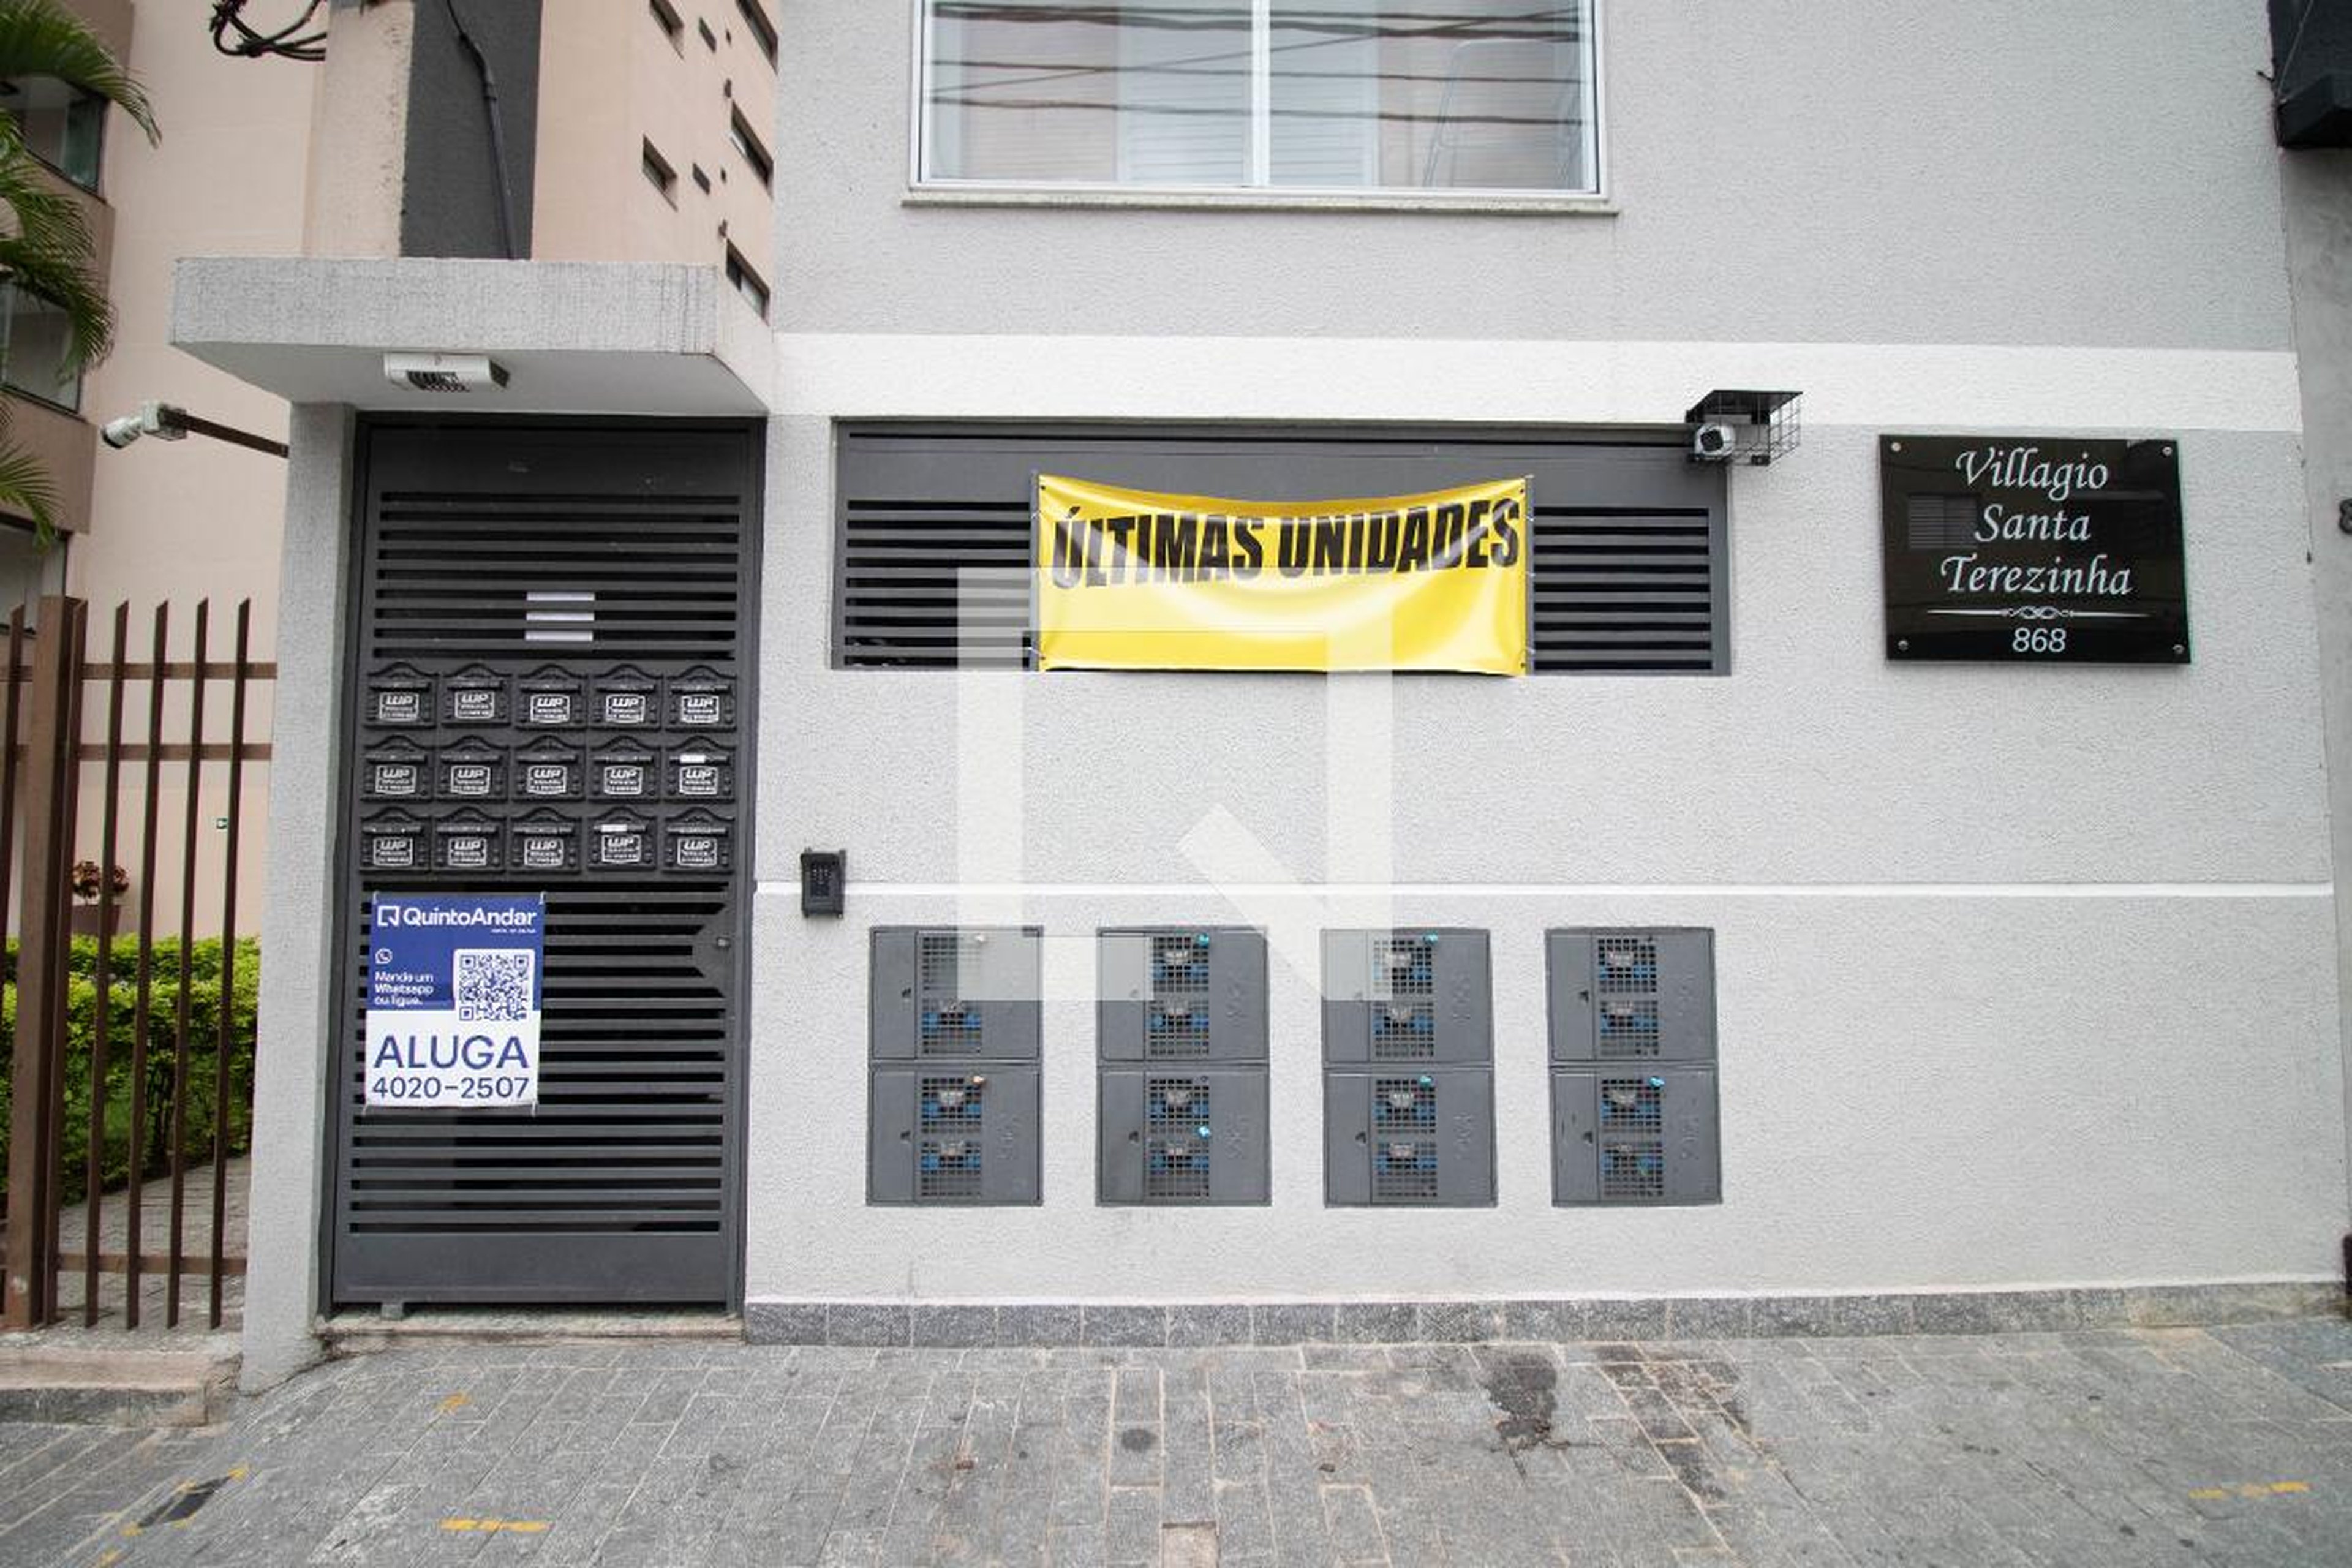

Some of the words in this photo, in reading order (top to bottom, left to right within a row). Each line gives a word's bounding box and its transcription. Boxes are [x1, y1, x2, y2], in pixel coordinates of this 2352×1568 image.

[1956, 447, 2108, 501] Villagio
[1975, 504, 2092, 542] Santa
[1051, 506, 1264, 589] ÚLTIMAS
[1276, 497, 1520, 578] UNIDADES
[1940, 553, 2133, 595] Terezinha
[2012, 628, 2067, 653] 868
[403, 907, 537, 927] QuintoAndar
[374, 1035, 529, 1069] ALUGA
[373, 1077, 529, 1099] 4020-2507
